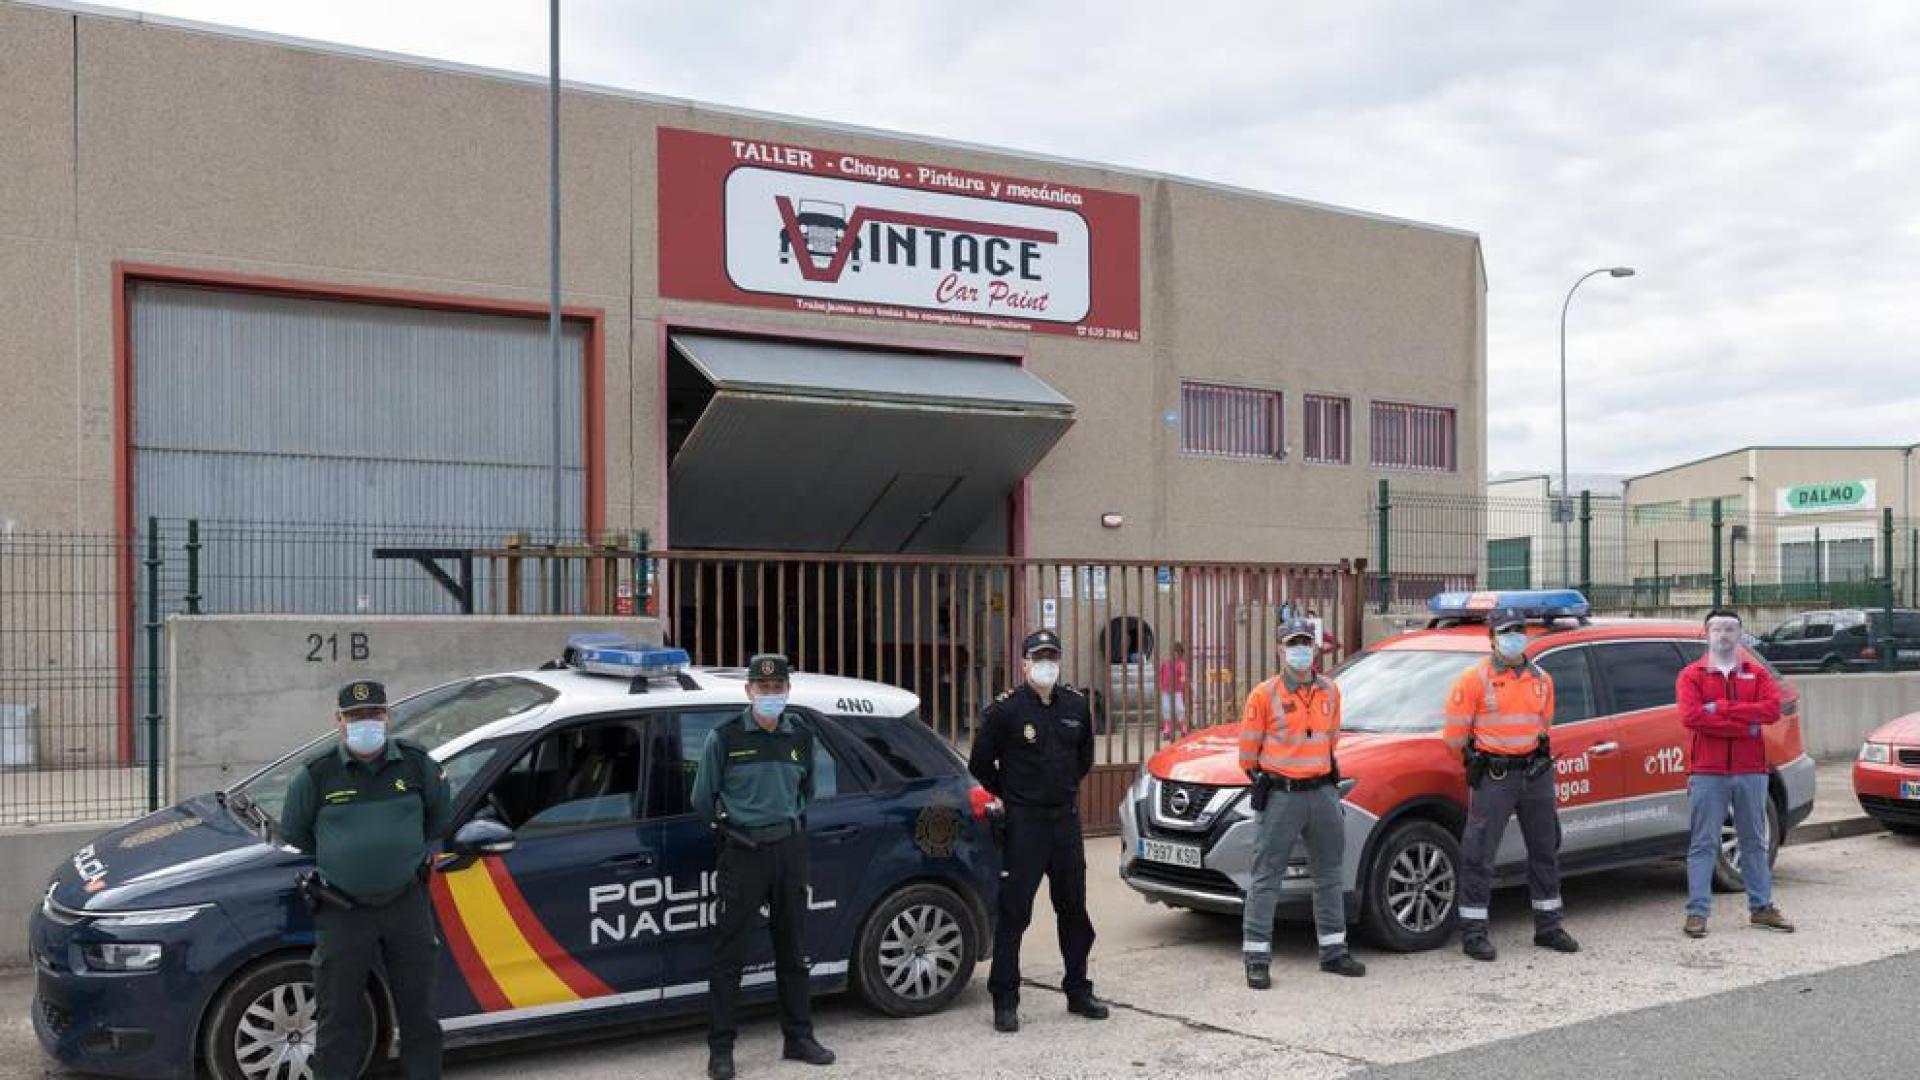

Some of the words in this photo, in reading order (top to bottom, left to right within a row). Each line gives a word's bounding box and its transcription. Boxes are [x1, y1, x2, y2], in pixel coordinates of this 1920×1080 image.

[731, 140, 815, 169] TALLER
[839, 156, 900, 182] Chapa
[917, 167, 985, 191] Pintura
[991, 180, 1001, 198] y
[1006, 183, 1083, 206] mecánica
[775, 195, 1058, 284] VINTAGE
[936, 273, 978, 304] Car
[987, 280, 1049, 312] Paint
[1799, 486, 1853, 504] DALMO
[306, 632, 337, 662] 21
[350, 632, 369, 661] B
[1552, 751, 1589, 775] oral
[1658, 745, 1685, 774] 112
[589, 869, 719, 914] POLI
